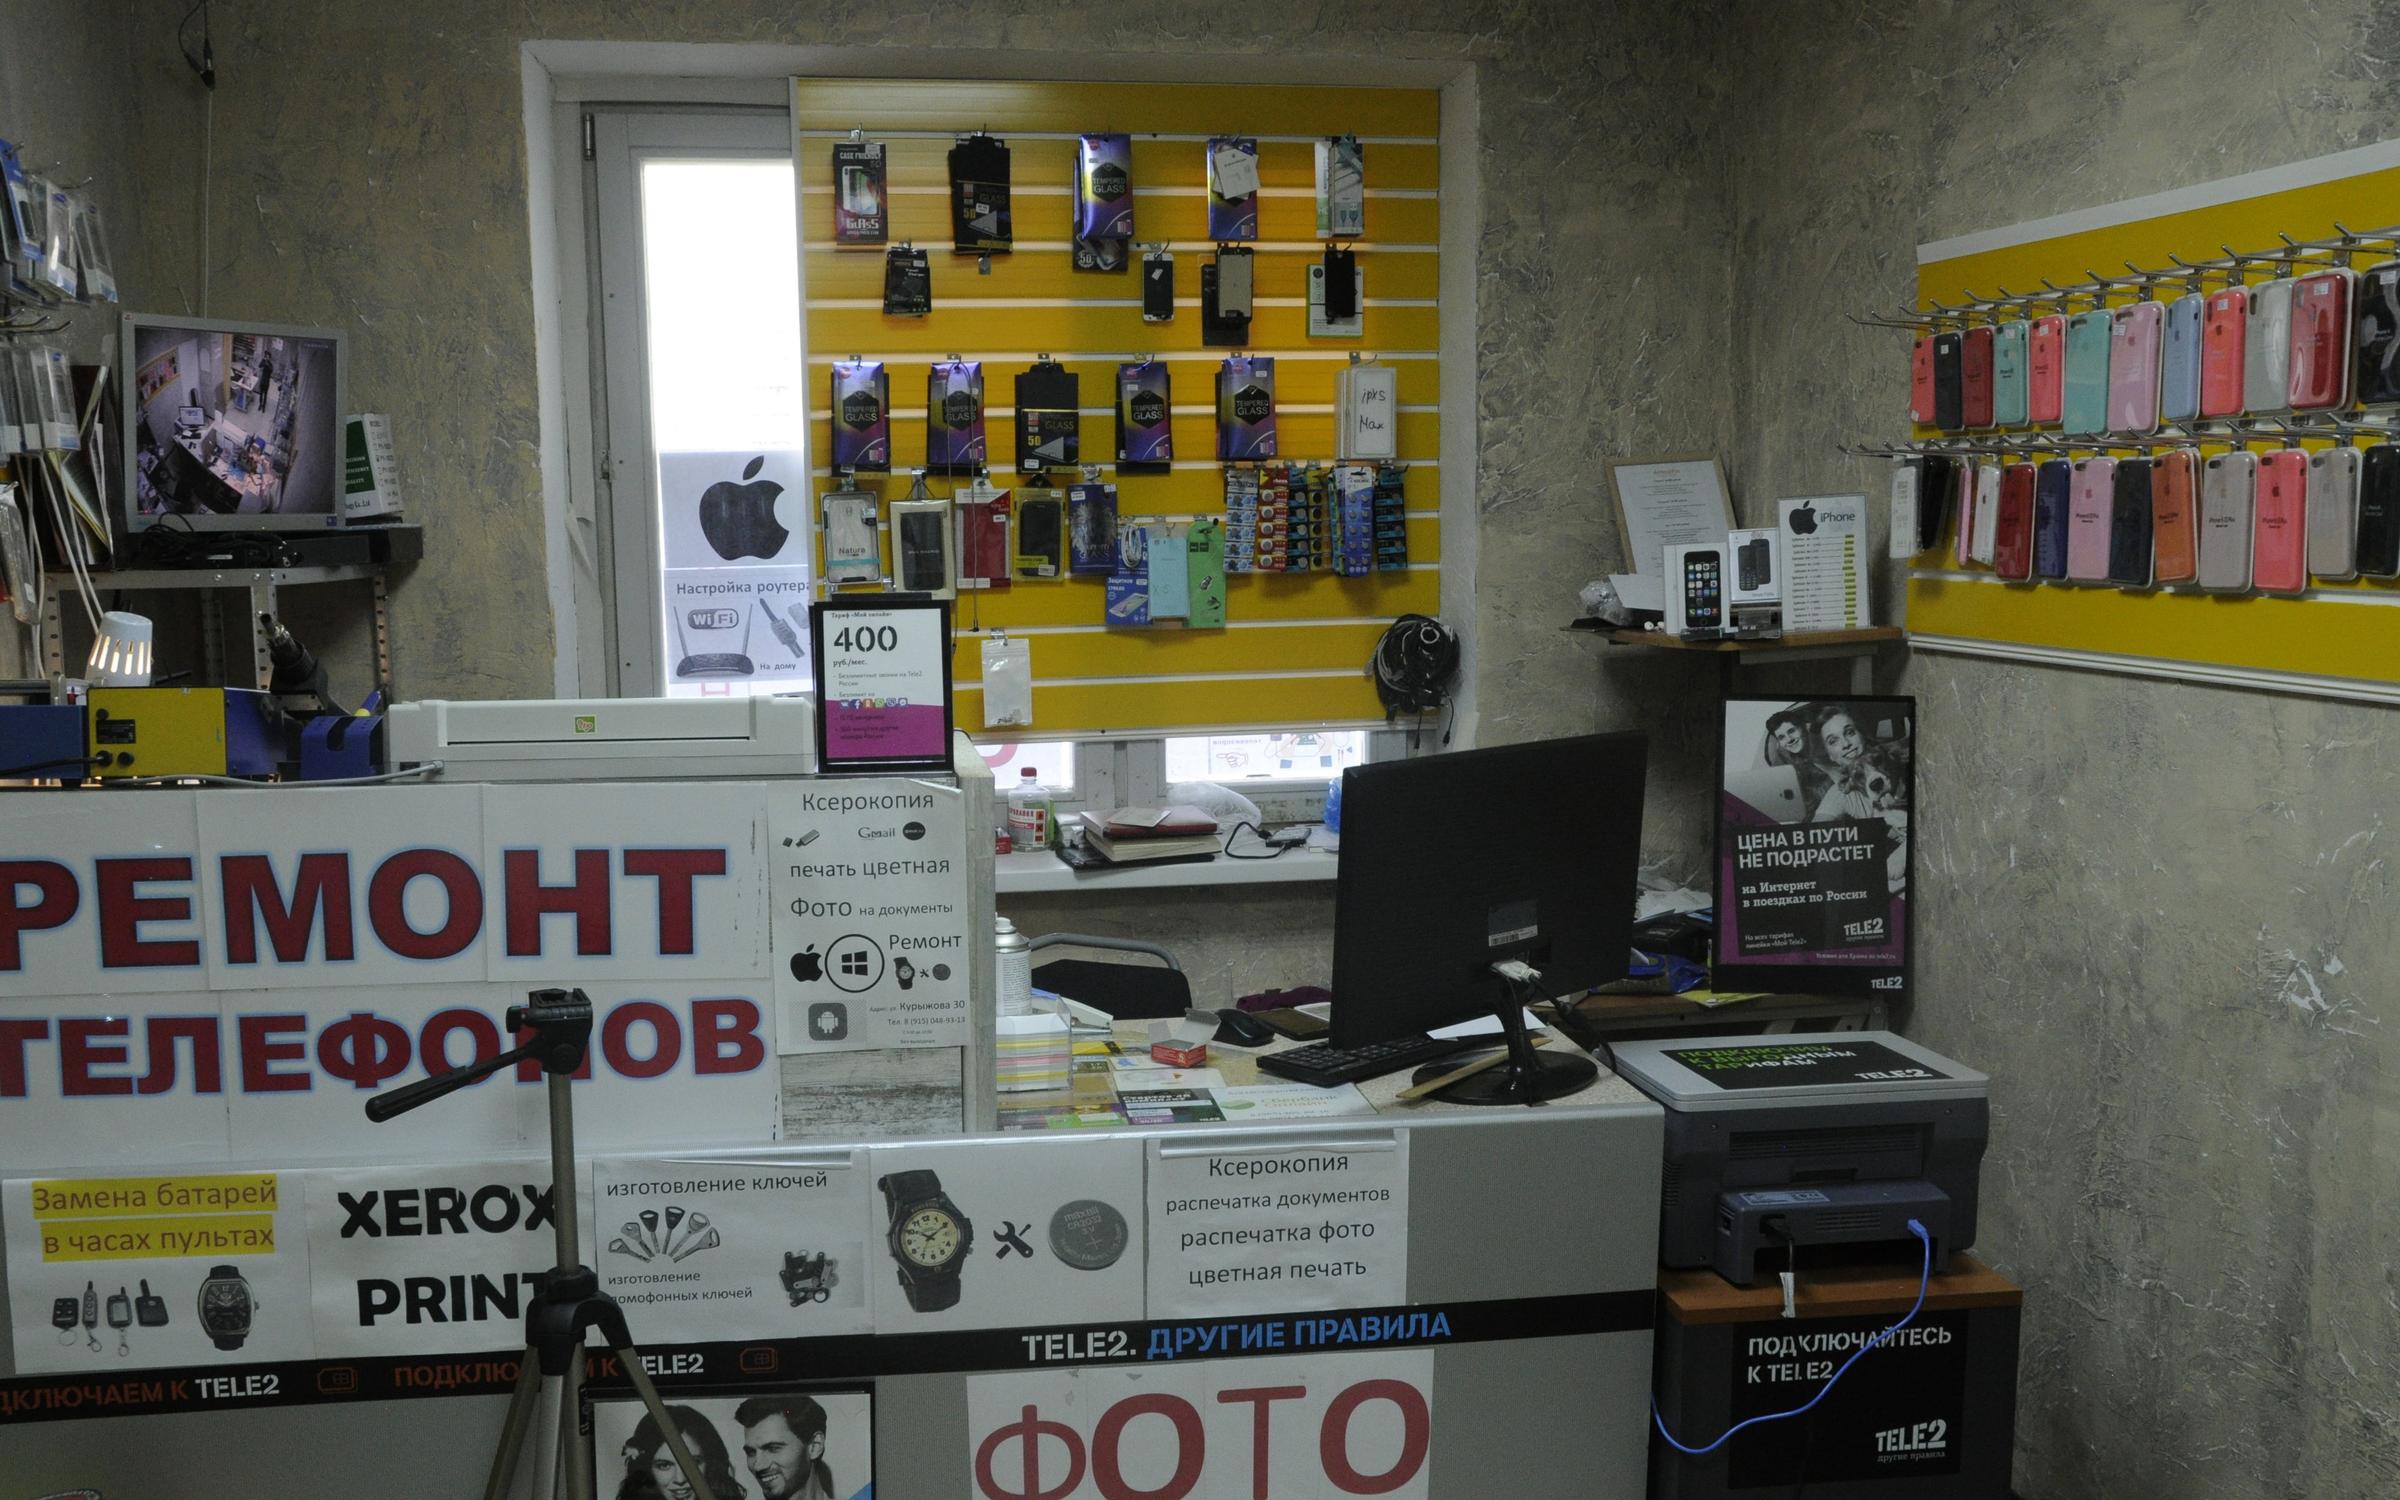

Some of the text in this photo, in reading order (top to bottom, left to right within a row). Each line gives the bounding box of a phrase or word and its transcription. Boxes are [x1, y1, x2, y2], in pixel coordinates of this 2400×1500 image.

[1094, 184, 1126, 193] GLASS
[845, 413, 879, 422] GLASS
[1132, 411, 1164, 421] GLASS
[1236, 407, 1269, 416] GLASS
[1820, 512, 1856, 523] iPhone
[676, 581, 752, 597] Настройка
[833, 625, 898, 653] 400
[774, 663, 796, 671] дому
[833, 658, 868, 668] руб./мес.
[802, 793, 934, 814] Ксерокопия
[857, 826, 895, 839] Gmail
[1738, 826, 1859, 852] ЦЕНА В ПУТИ
[1739, 844, 1875, 869] НЕ ПОДРАСТЕТ
[790, 859, 950, 879] печать цветная
[1742, 880, 1817, 895] на Интернет
[0, 848, 727, 971] РЕМОНТ
[790, 897, 953, 919] Фото на документы
[1743, 890, 1868, 908] в поездках по России
[1843, 917, 1884, 937] TELE2
[888, 934, 962, 951] Ремонт
[1871, 976, 1904, 990] TELE2
[953, 1000, 966, 1009] 30
[1854, 1068, 1933, 1081] TELE2
[1208, 1155, 1349, 1181] Ксерокопия
[606, 1171, 828, 1198] изготовление ключей
[34, 1180, 277, 1212] Замена батарей
[1166, 1186, 1390, 1216] распечатка документов
[338, 1183, 555, 1239] XEROX
[44, 1227, 275, 1254] в часах пультах
[1180, 1220, 1376, 1251] распечатка фото
[608, 1272, 701, 1285] изготовление
[1188, 1259, 1367, 1288] цветная печать
[702, 1287, 753, 1302] ключей
[1022, 1311, 1452, 1361] TELE2. ДРУГИЕ ПРАВИЛА
[1748, 1325, 1952, 1358] ПОДКЛЮЧАЙТЕСЬ
[601, 1358, 619, 1377] К
[636, 1353, 705, 1376] ELE2
[1748, 1360, 1834, 1384] К TELE2
[169, 1383, 189, 1401] К
[194, 1373, 281, 1401] TELE2
[975, 1378, 1430, 1500] ФОТО
[1875, 1418, 1947, 1453] TELE2
